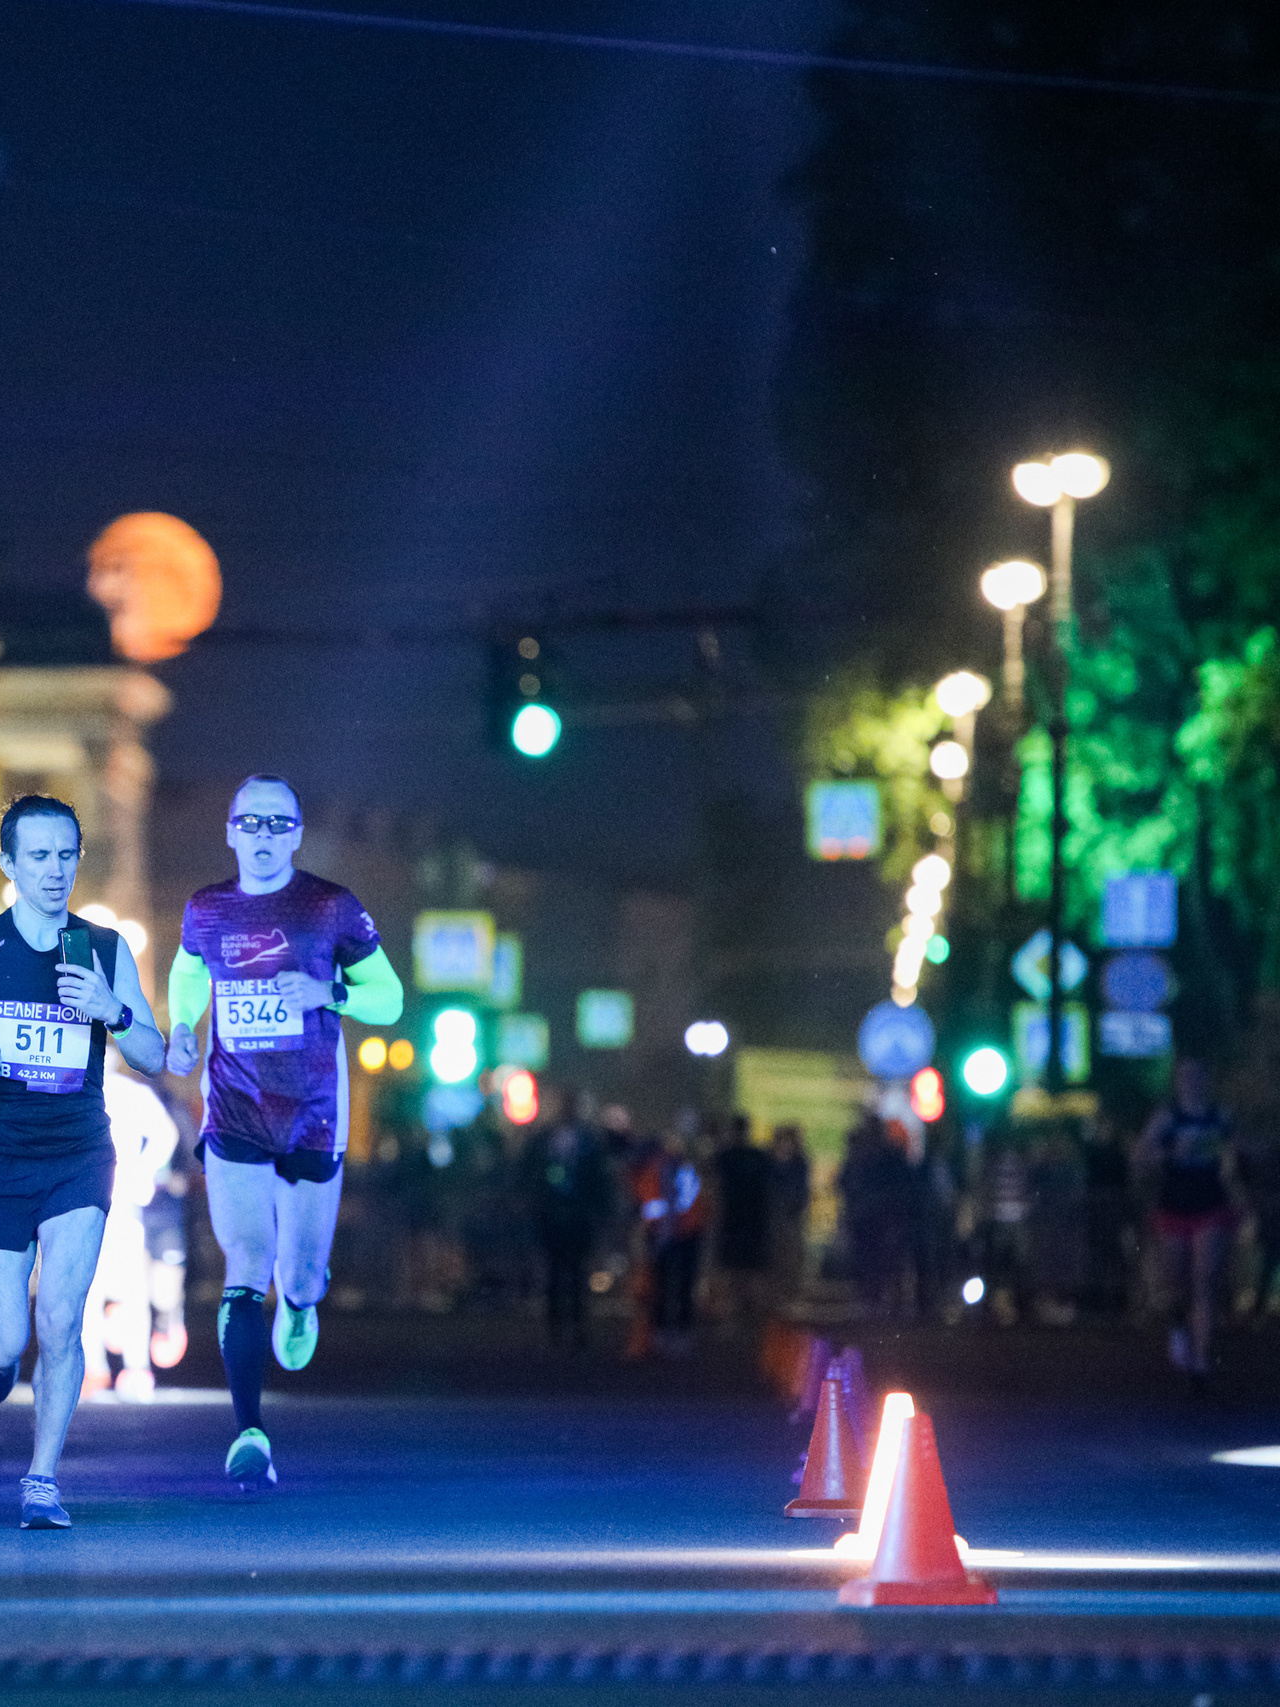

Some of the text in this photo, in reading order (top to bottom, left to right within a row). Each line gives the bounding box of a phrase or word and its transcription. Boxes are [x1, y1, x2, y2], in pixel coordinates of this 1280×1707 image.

[228, 1000, 288, 1025] 5346
[15, 1024, 63, 1054] 511
[29, 1054, 52, 1064] PETR
[17, 1069, 38, 1080] 42,2
